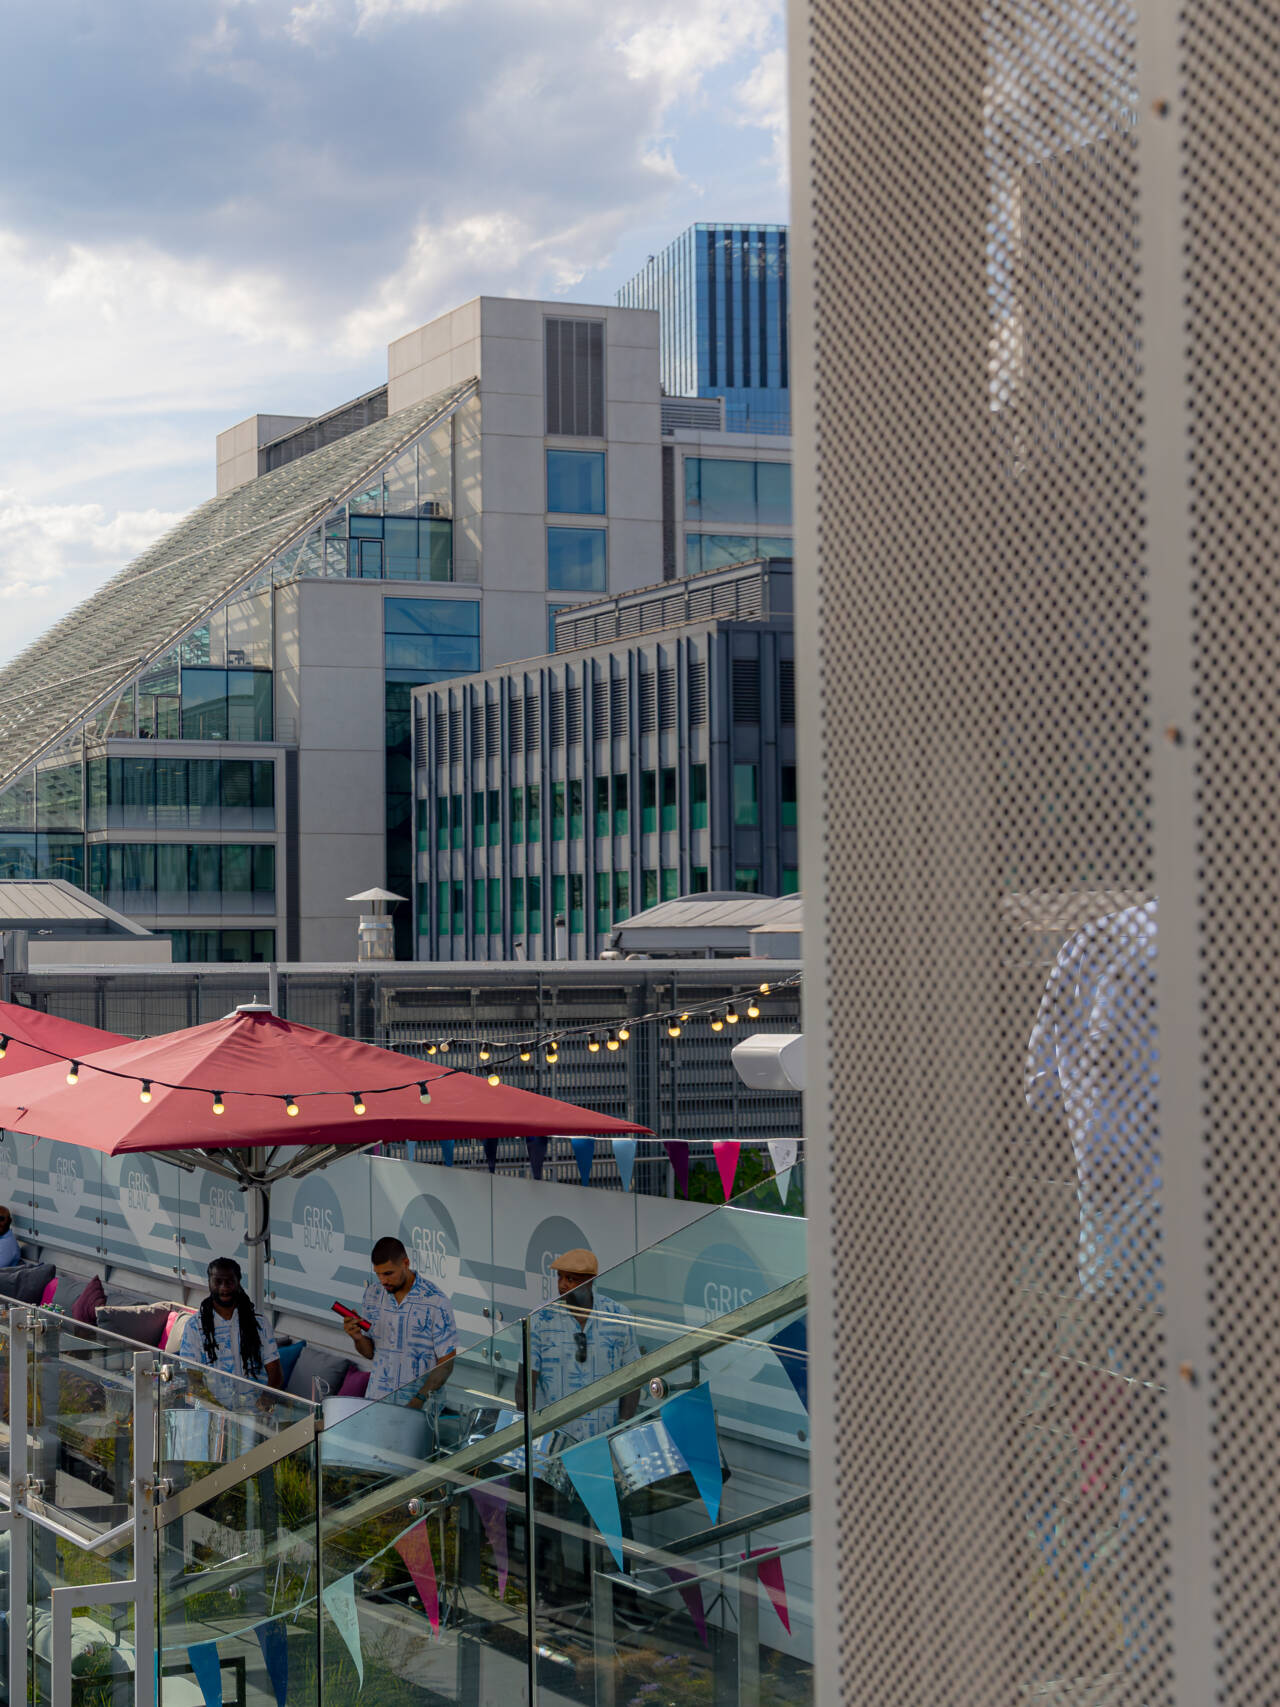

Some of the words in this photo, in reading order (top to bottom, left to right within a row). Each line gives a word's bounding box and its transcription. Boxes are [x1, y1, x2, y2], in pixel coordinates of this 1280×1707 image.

[56, 1156, 76, 1178] GRIS
[127, 1170, 151, 1193] GRIS
[209, 1186, 235, 1212] GRIS
[209, 1206, 235, 1232] BLANC
[303, 1205, 333, 1233] GRIS
[303, 1226, 334, 1254] BLANC
[411, 1226, 446, 1256] GRIS
[411, 1250, 447, 1279] BLANC
